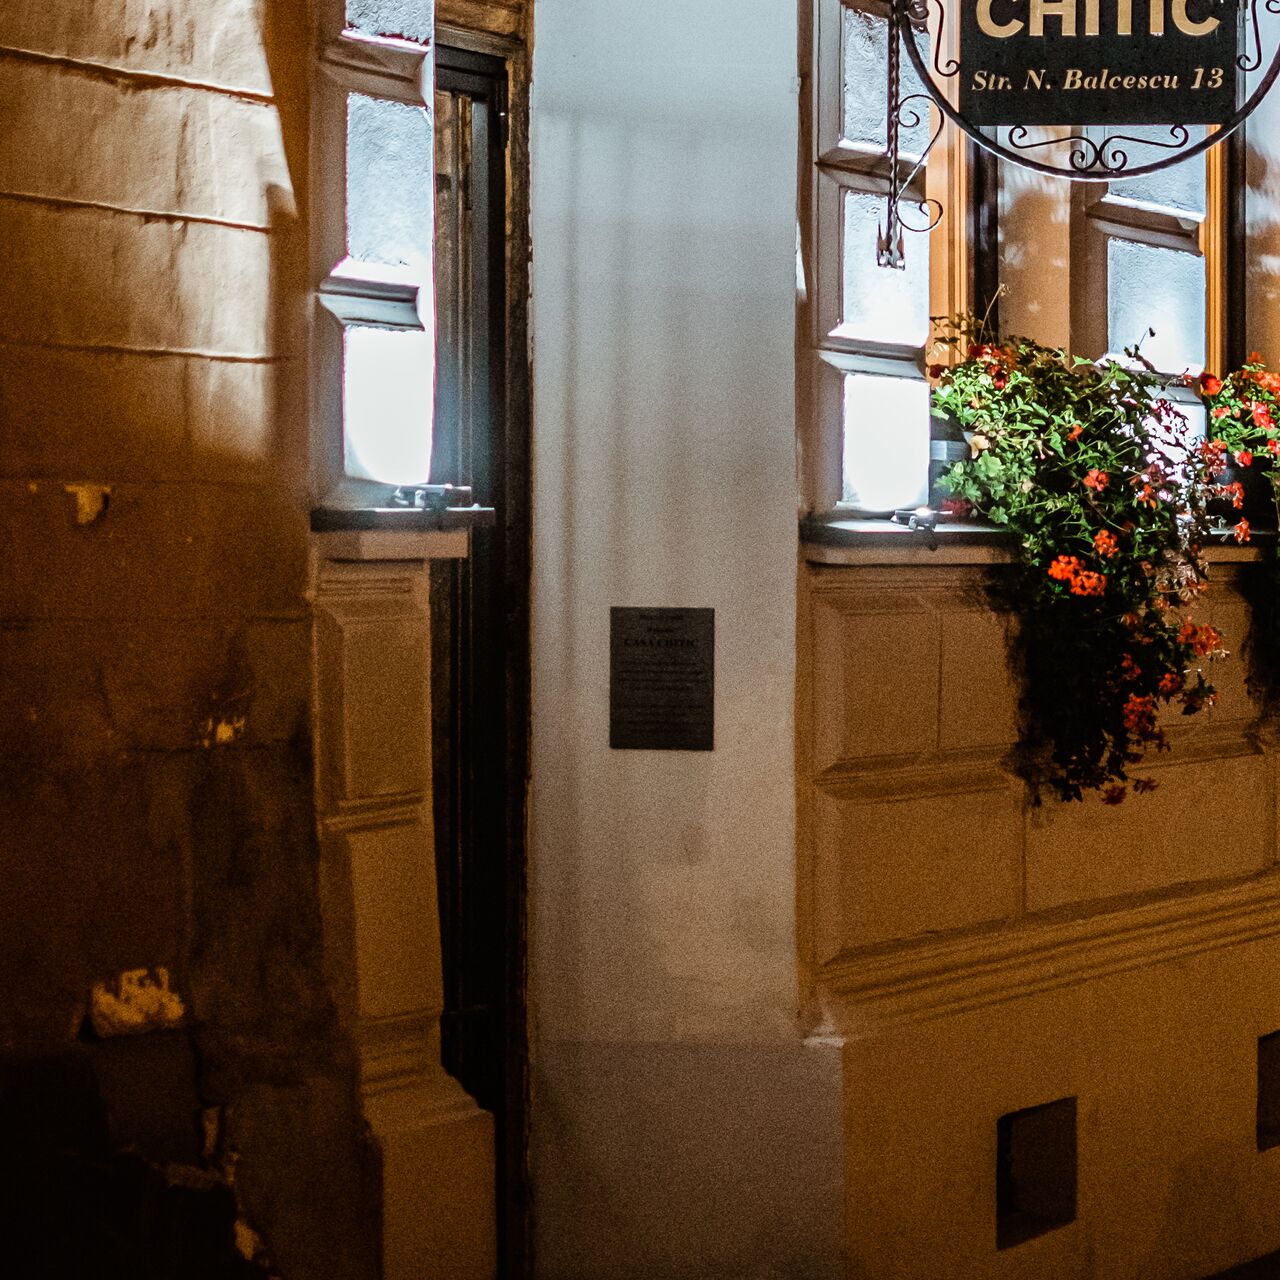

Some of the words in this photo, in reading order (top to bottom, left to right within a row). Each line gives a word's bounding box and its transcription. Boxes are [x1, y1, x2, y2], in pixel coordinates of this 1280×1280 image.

[971, 69, 1012, 91] Str.
[1022, 69, 1051, 91] N.
[1062, 68, 1180, 91] Balcescu
[1190, 67, 1225, 90] 13
